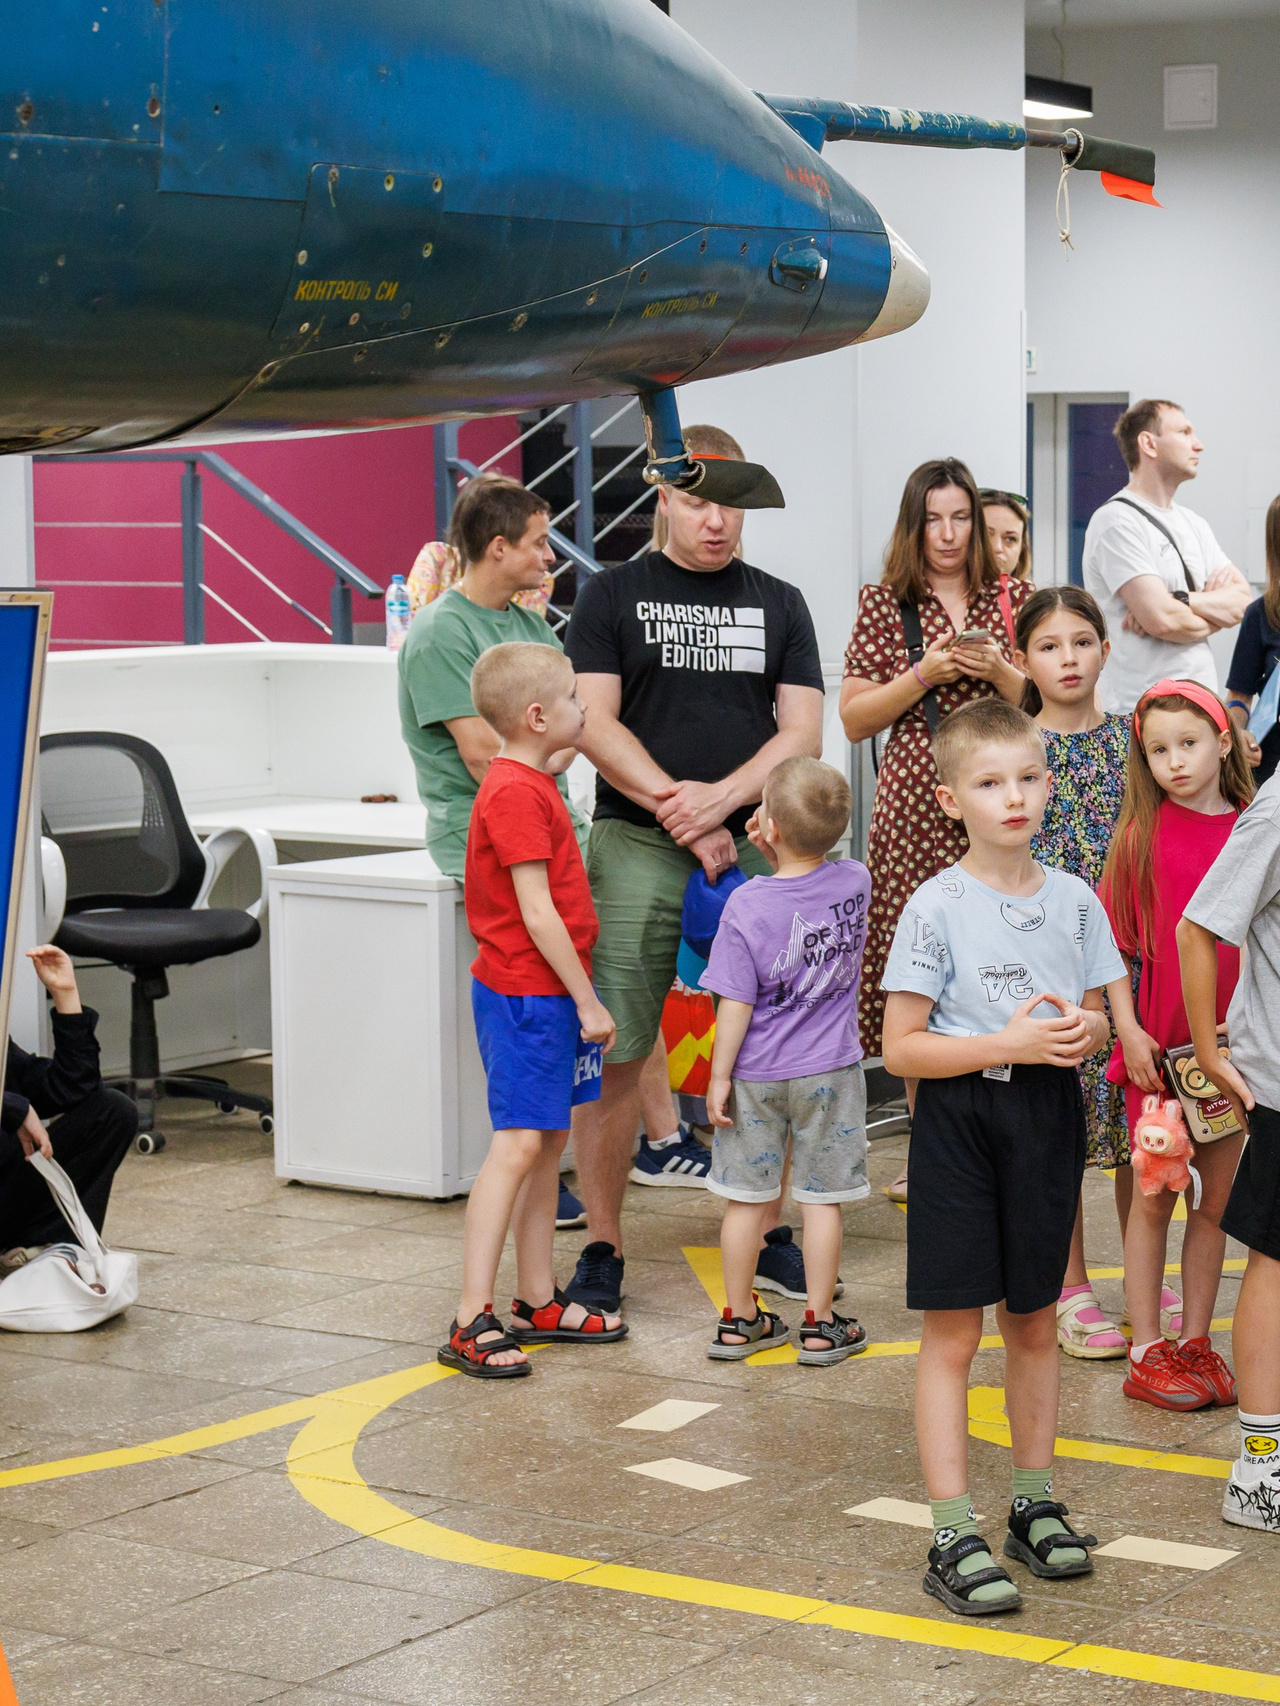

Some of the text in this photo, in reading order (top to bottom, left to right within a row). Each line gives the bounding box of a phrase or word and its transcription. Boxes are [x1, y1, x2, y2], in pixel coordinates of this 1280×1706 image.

[294, 280, 399, 301] КОНТРОЛЬ СИ
[636, 601, 734, 626] CHARISMA
[645, 621, 718, 647] LIMITED
[662, 643, 731, 672] EDITION
[829, 893, 865, 920] TOP
[803, 912, 864, 948] OF THE
[803, 934, 862, 968] WORLD
[1244, 1454, 1280, 1465] DREAM
